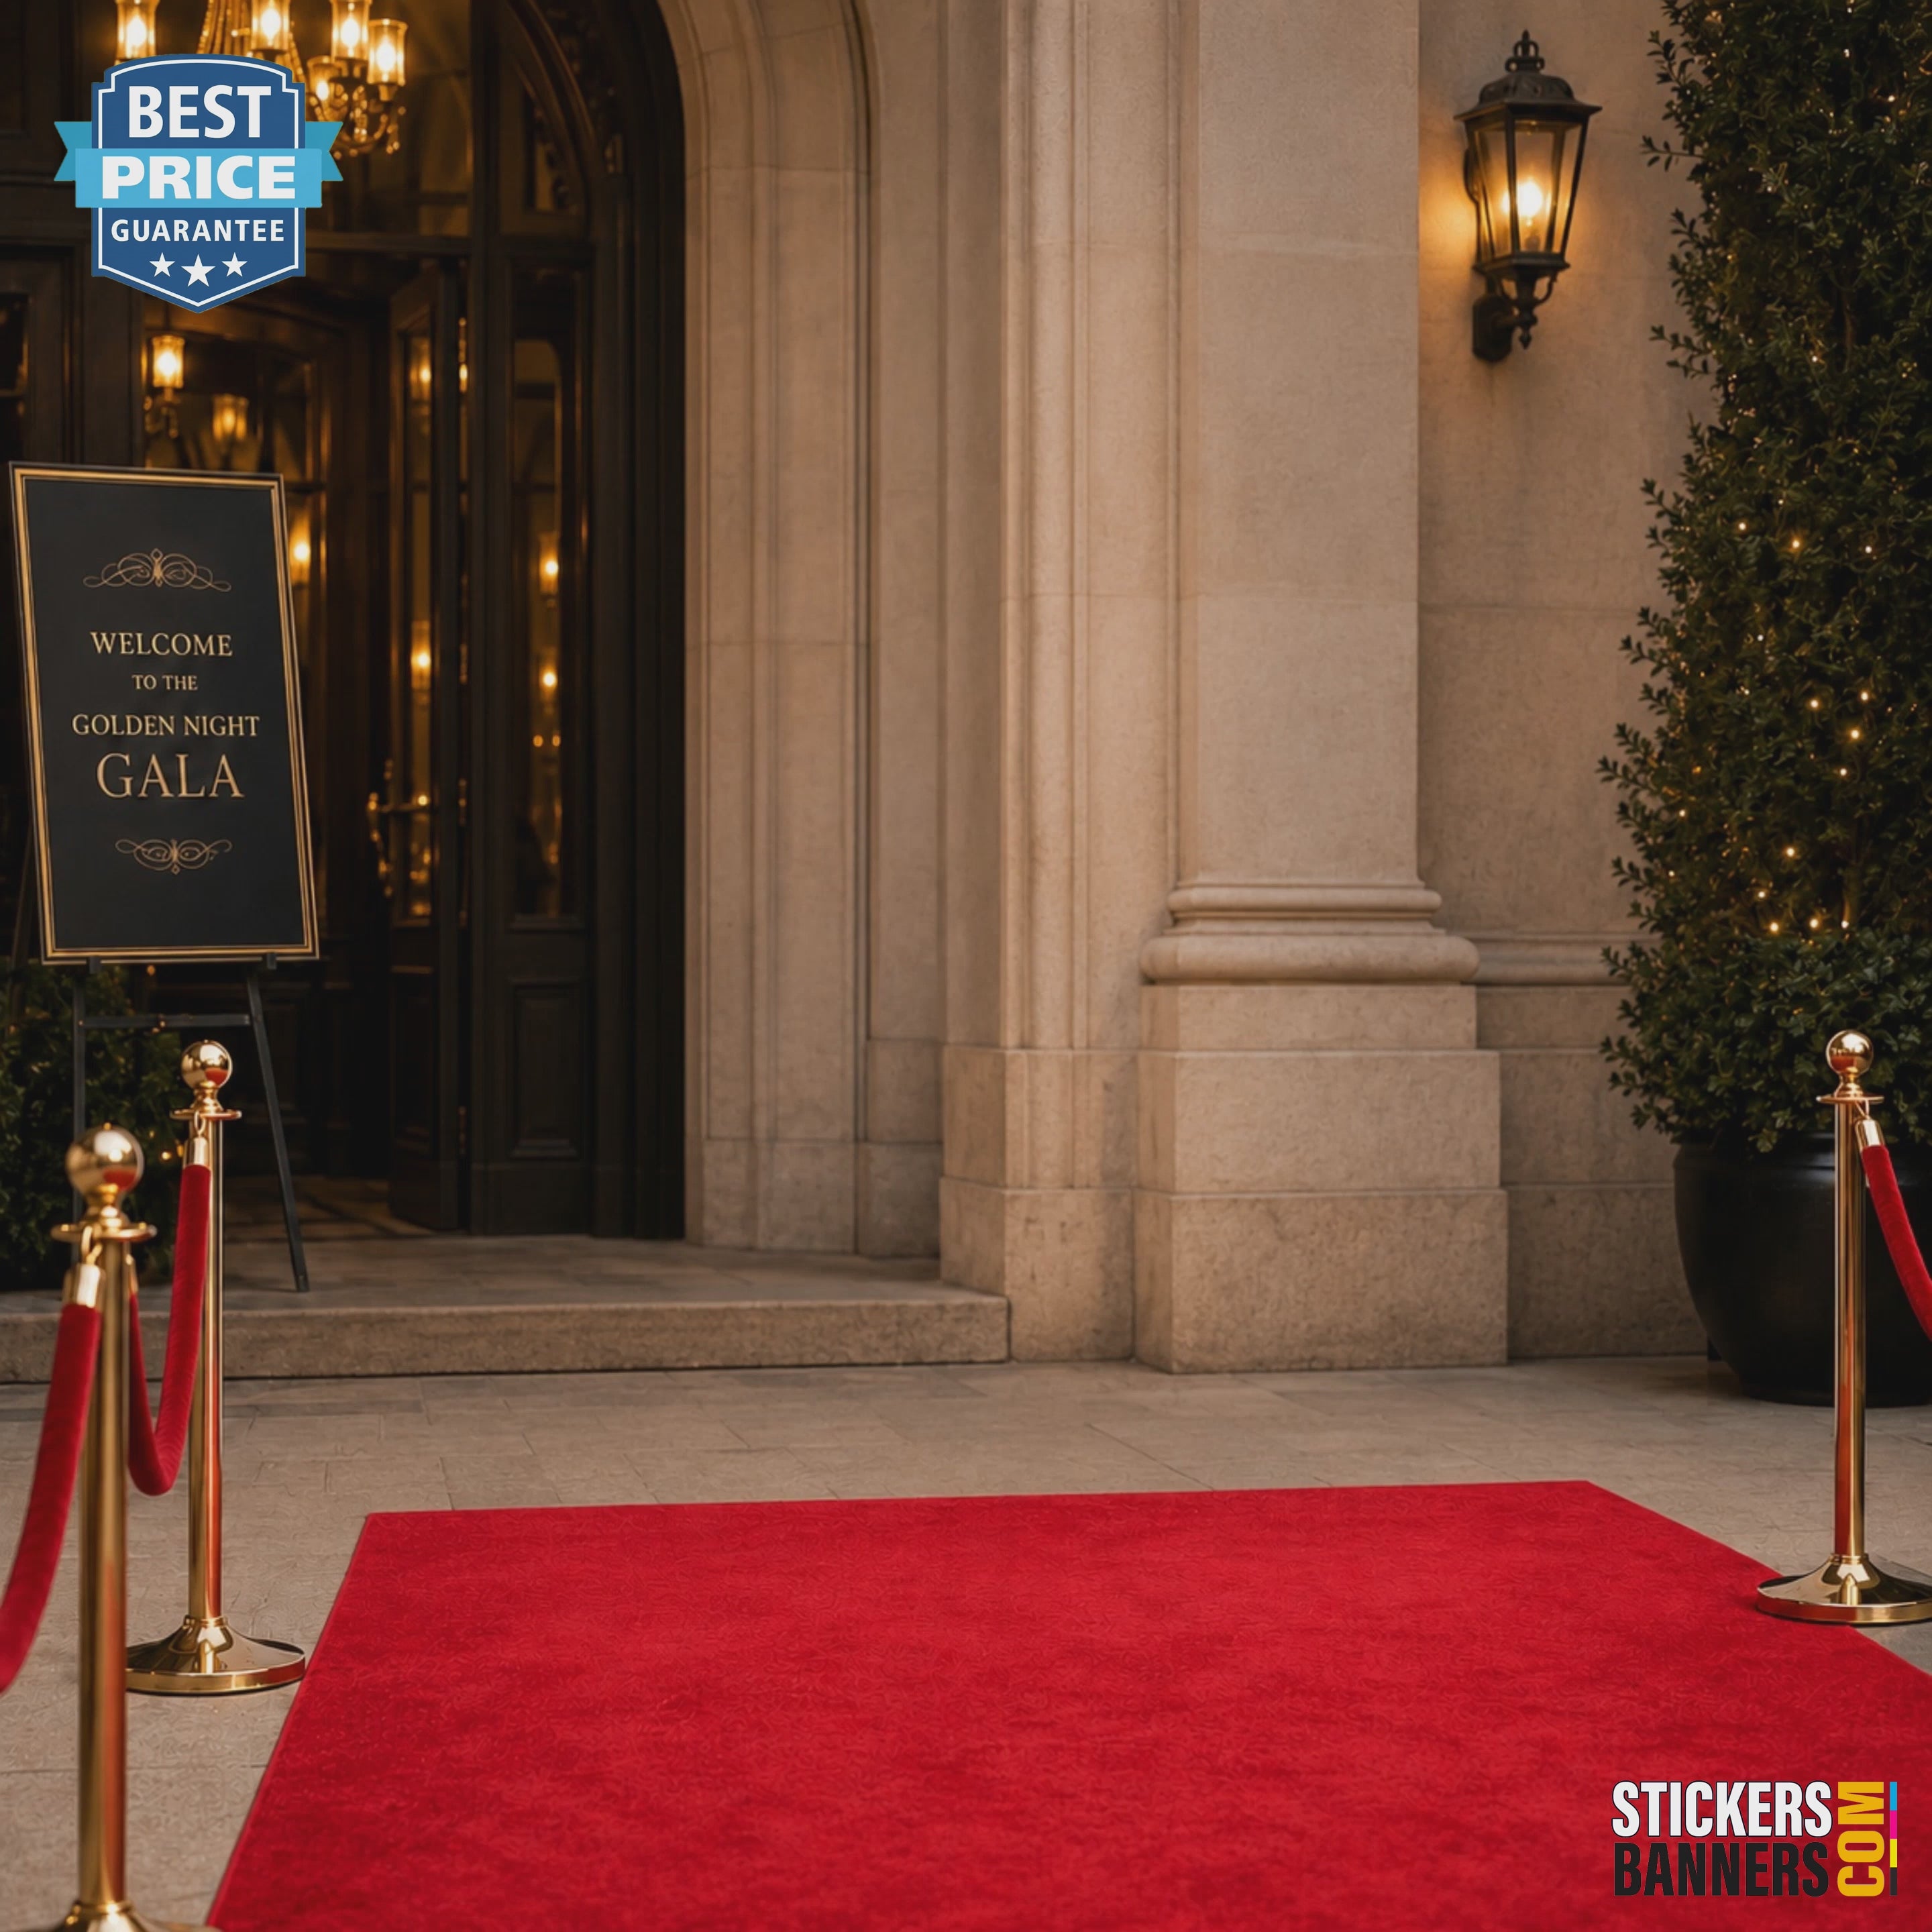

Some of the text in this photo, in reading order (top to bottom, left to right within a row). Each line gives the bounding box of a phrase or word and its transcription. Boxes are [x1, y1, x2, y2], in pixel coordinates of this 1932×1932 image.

[90, 631, 233, 657] WELCOME
[132, 674, 198, 691] TO THE
[72, 714, 260, 737] GOLDEN NIGHT
[96, 753, 245, 798] GALA
